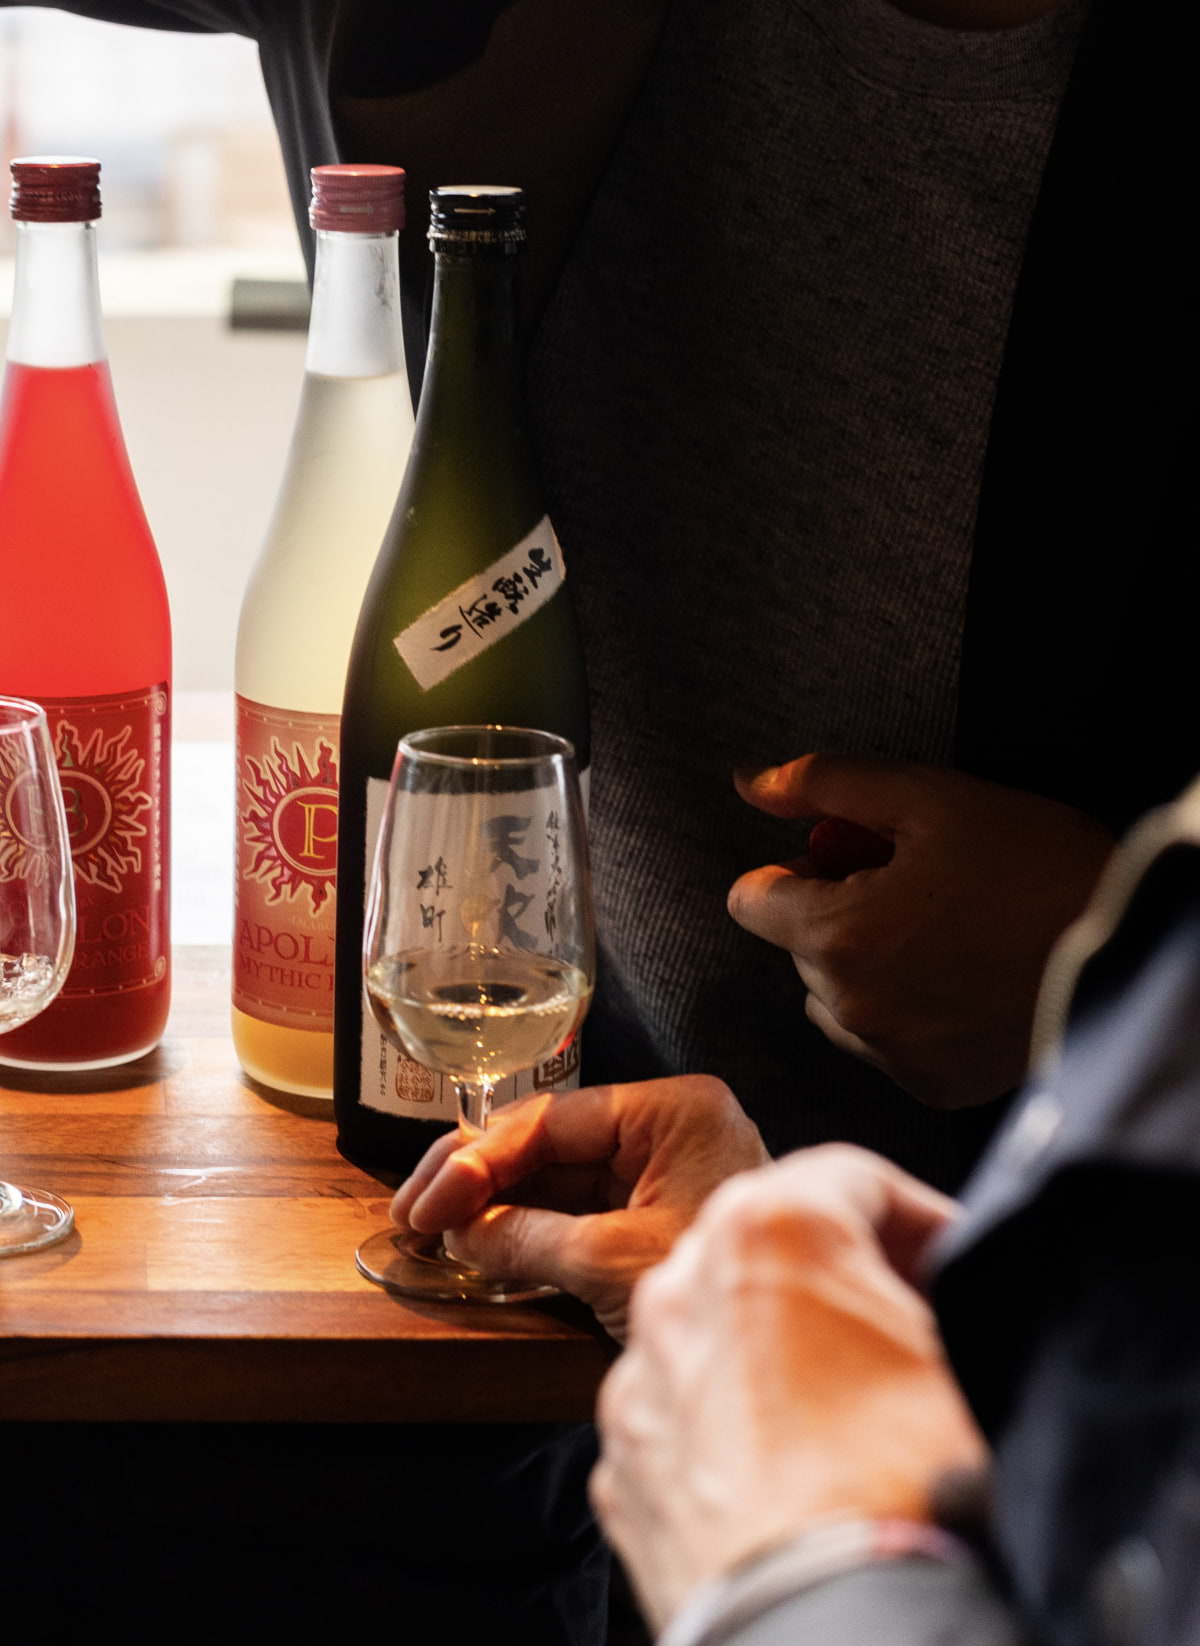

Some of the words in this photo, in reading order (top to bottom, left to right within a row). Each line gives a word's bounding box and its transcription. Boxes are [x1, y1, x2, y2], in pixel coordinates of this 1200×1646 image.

[75, 943, 150, 970] RANGE
[239, 918, 337, 968] APOL
[239, 954, 322, 990] MYTHIC
